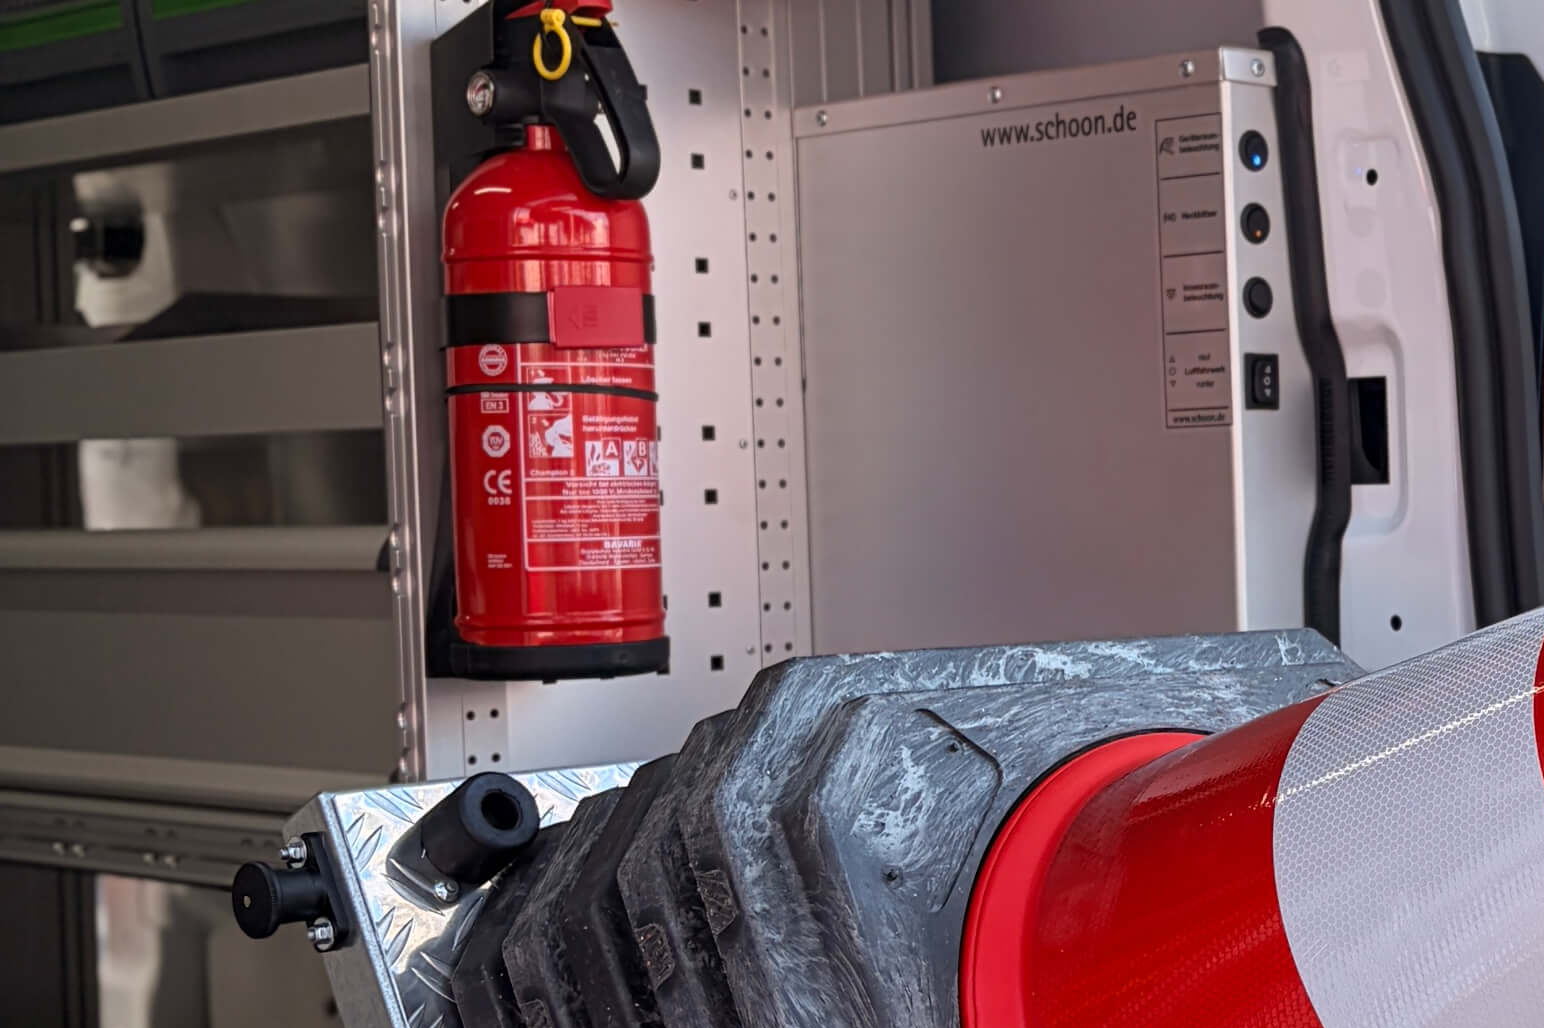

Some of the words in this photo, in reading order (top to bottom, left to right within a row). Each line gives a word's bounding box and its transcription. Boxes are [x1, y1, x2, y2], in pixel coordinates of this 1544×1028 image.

[981, 105, 1137, 147] www.schoon.de
[1173, 412, 1225, 424] www.schoon.de
[606, 441, 619, 456] A
[638, 441, 647, 456] B
